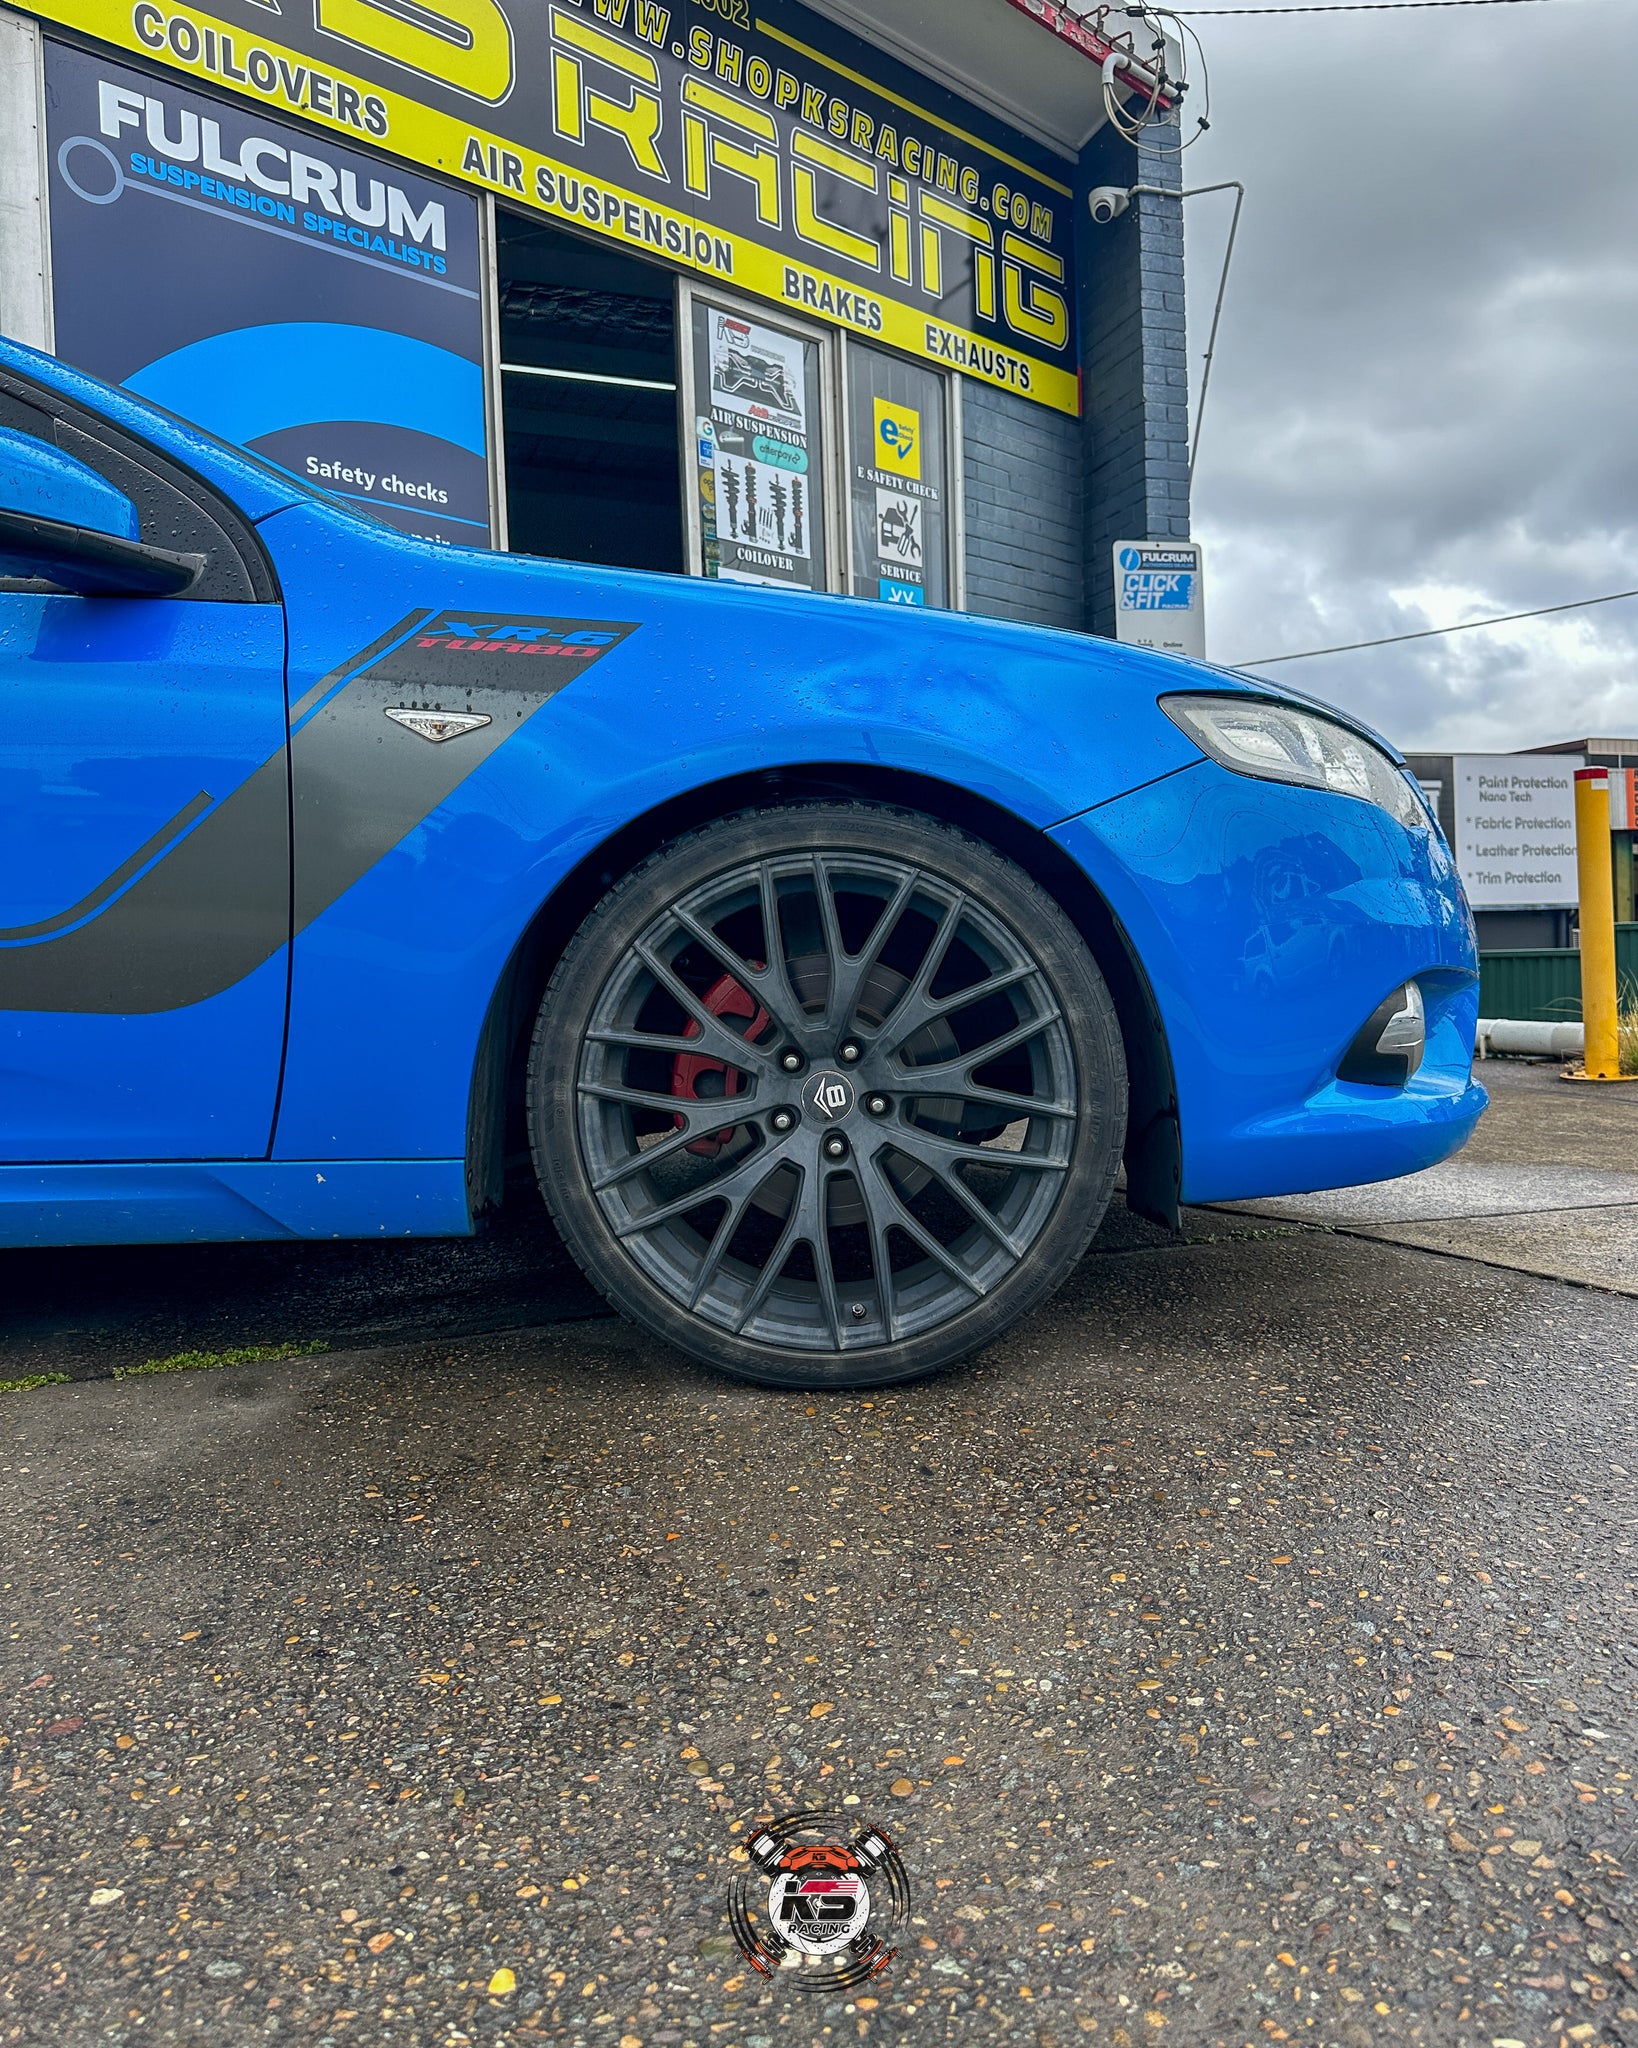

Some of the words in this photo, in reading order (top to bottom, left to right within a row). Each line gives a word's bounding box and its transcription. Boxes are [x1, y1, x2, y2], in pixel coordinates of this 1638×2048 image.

[131, 0, 390, 139] COILOVERS
[562, 0, 1054, 242] WW.SHOPKSRACING.COM
[98, 80, 447, 252] FULCRUM
[549, 3, 1070, 351] RACING
[130, 152, 295, 225] SUSPENSION
[303, 211, 447, 275] SPECIALISTS
[460, 135, 528, 195] AIR
[534, 163, 734, 276] SUSPENSION
[783, 265, 884, 333] BRAKES
[924, 323, 1032, 392] EXHAUSTS
[710, 407, 736, 427] AIR
[735, 415, 808, 450] SUSPENSION
[759, 444, 792, 462] afterpay
[305, 456, 377, 492] Safety
[381, 474, 449, 504] checks
[857, 465, 865, 479] E
[866, 468, 903, 490] SAFETY
[905, 481, 939, 501] CHECK
[736, 547, 794, 572] COILOVER
[1142, 552, 1194, 563] FULCRUM
[880, 563, 922, 584] SERVICE
[1126, 574, 1181, 592] CLICK
[1120, 591, 1164, 609] &FIT
[423, 621, 621, 646] XR-6
[415, 637, 600, 658] TURBO
[1479, 776, 1509, 789] Paint
[1511, 776, 1568, 789] Protection
[1510, 791, 1532, 802] Tech
[1475, 817, 1512, 829] Fabric
[1515, 818, 1571, 829] Protection
[1476, 844, 1519, 857] Leather
[1476, 872, 1501, 884] Trim
[1505, 872, 1561, 884] Protection
